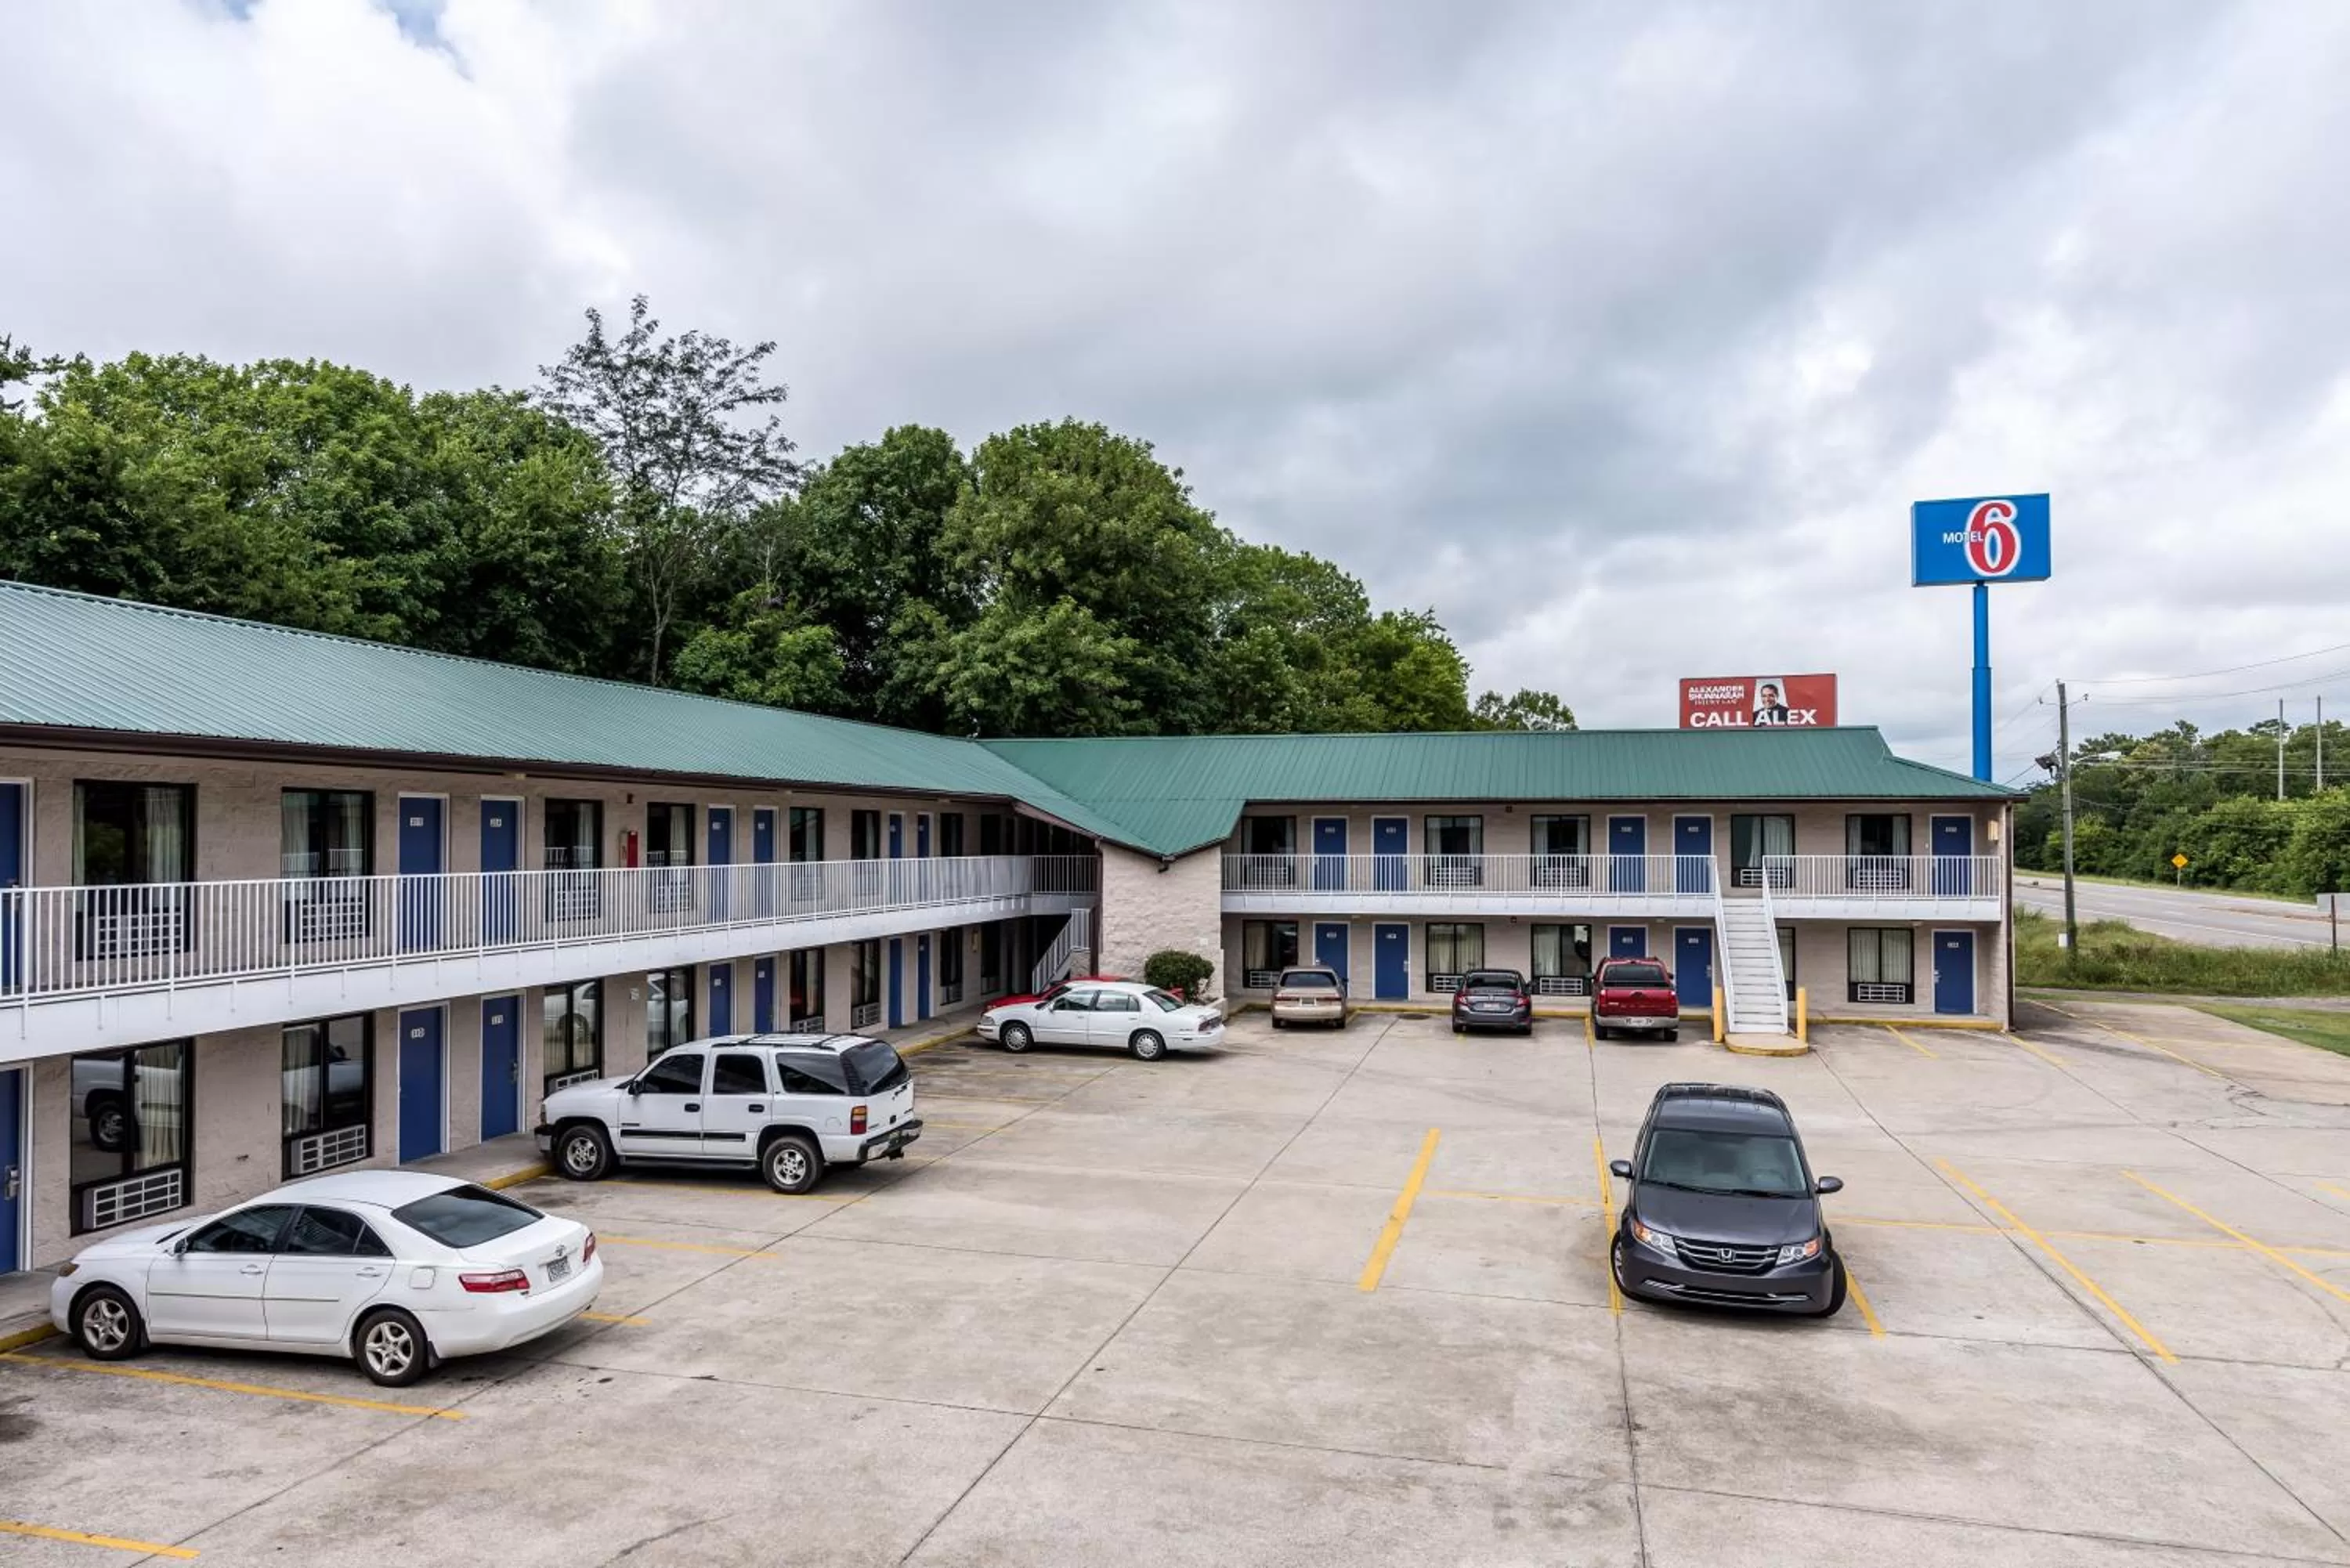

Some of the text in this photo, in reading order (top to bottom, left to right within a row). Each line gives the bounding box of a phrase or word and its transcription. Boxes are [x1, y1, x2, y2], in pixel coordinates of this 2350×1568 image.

[1943, 500, 2022, 576] MOTEL 6
[1690, 709, 1817, 727] CALL ALEX
